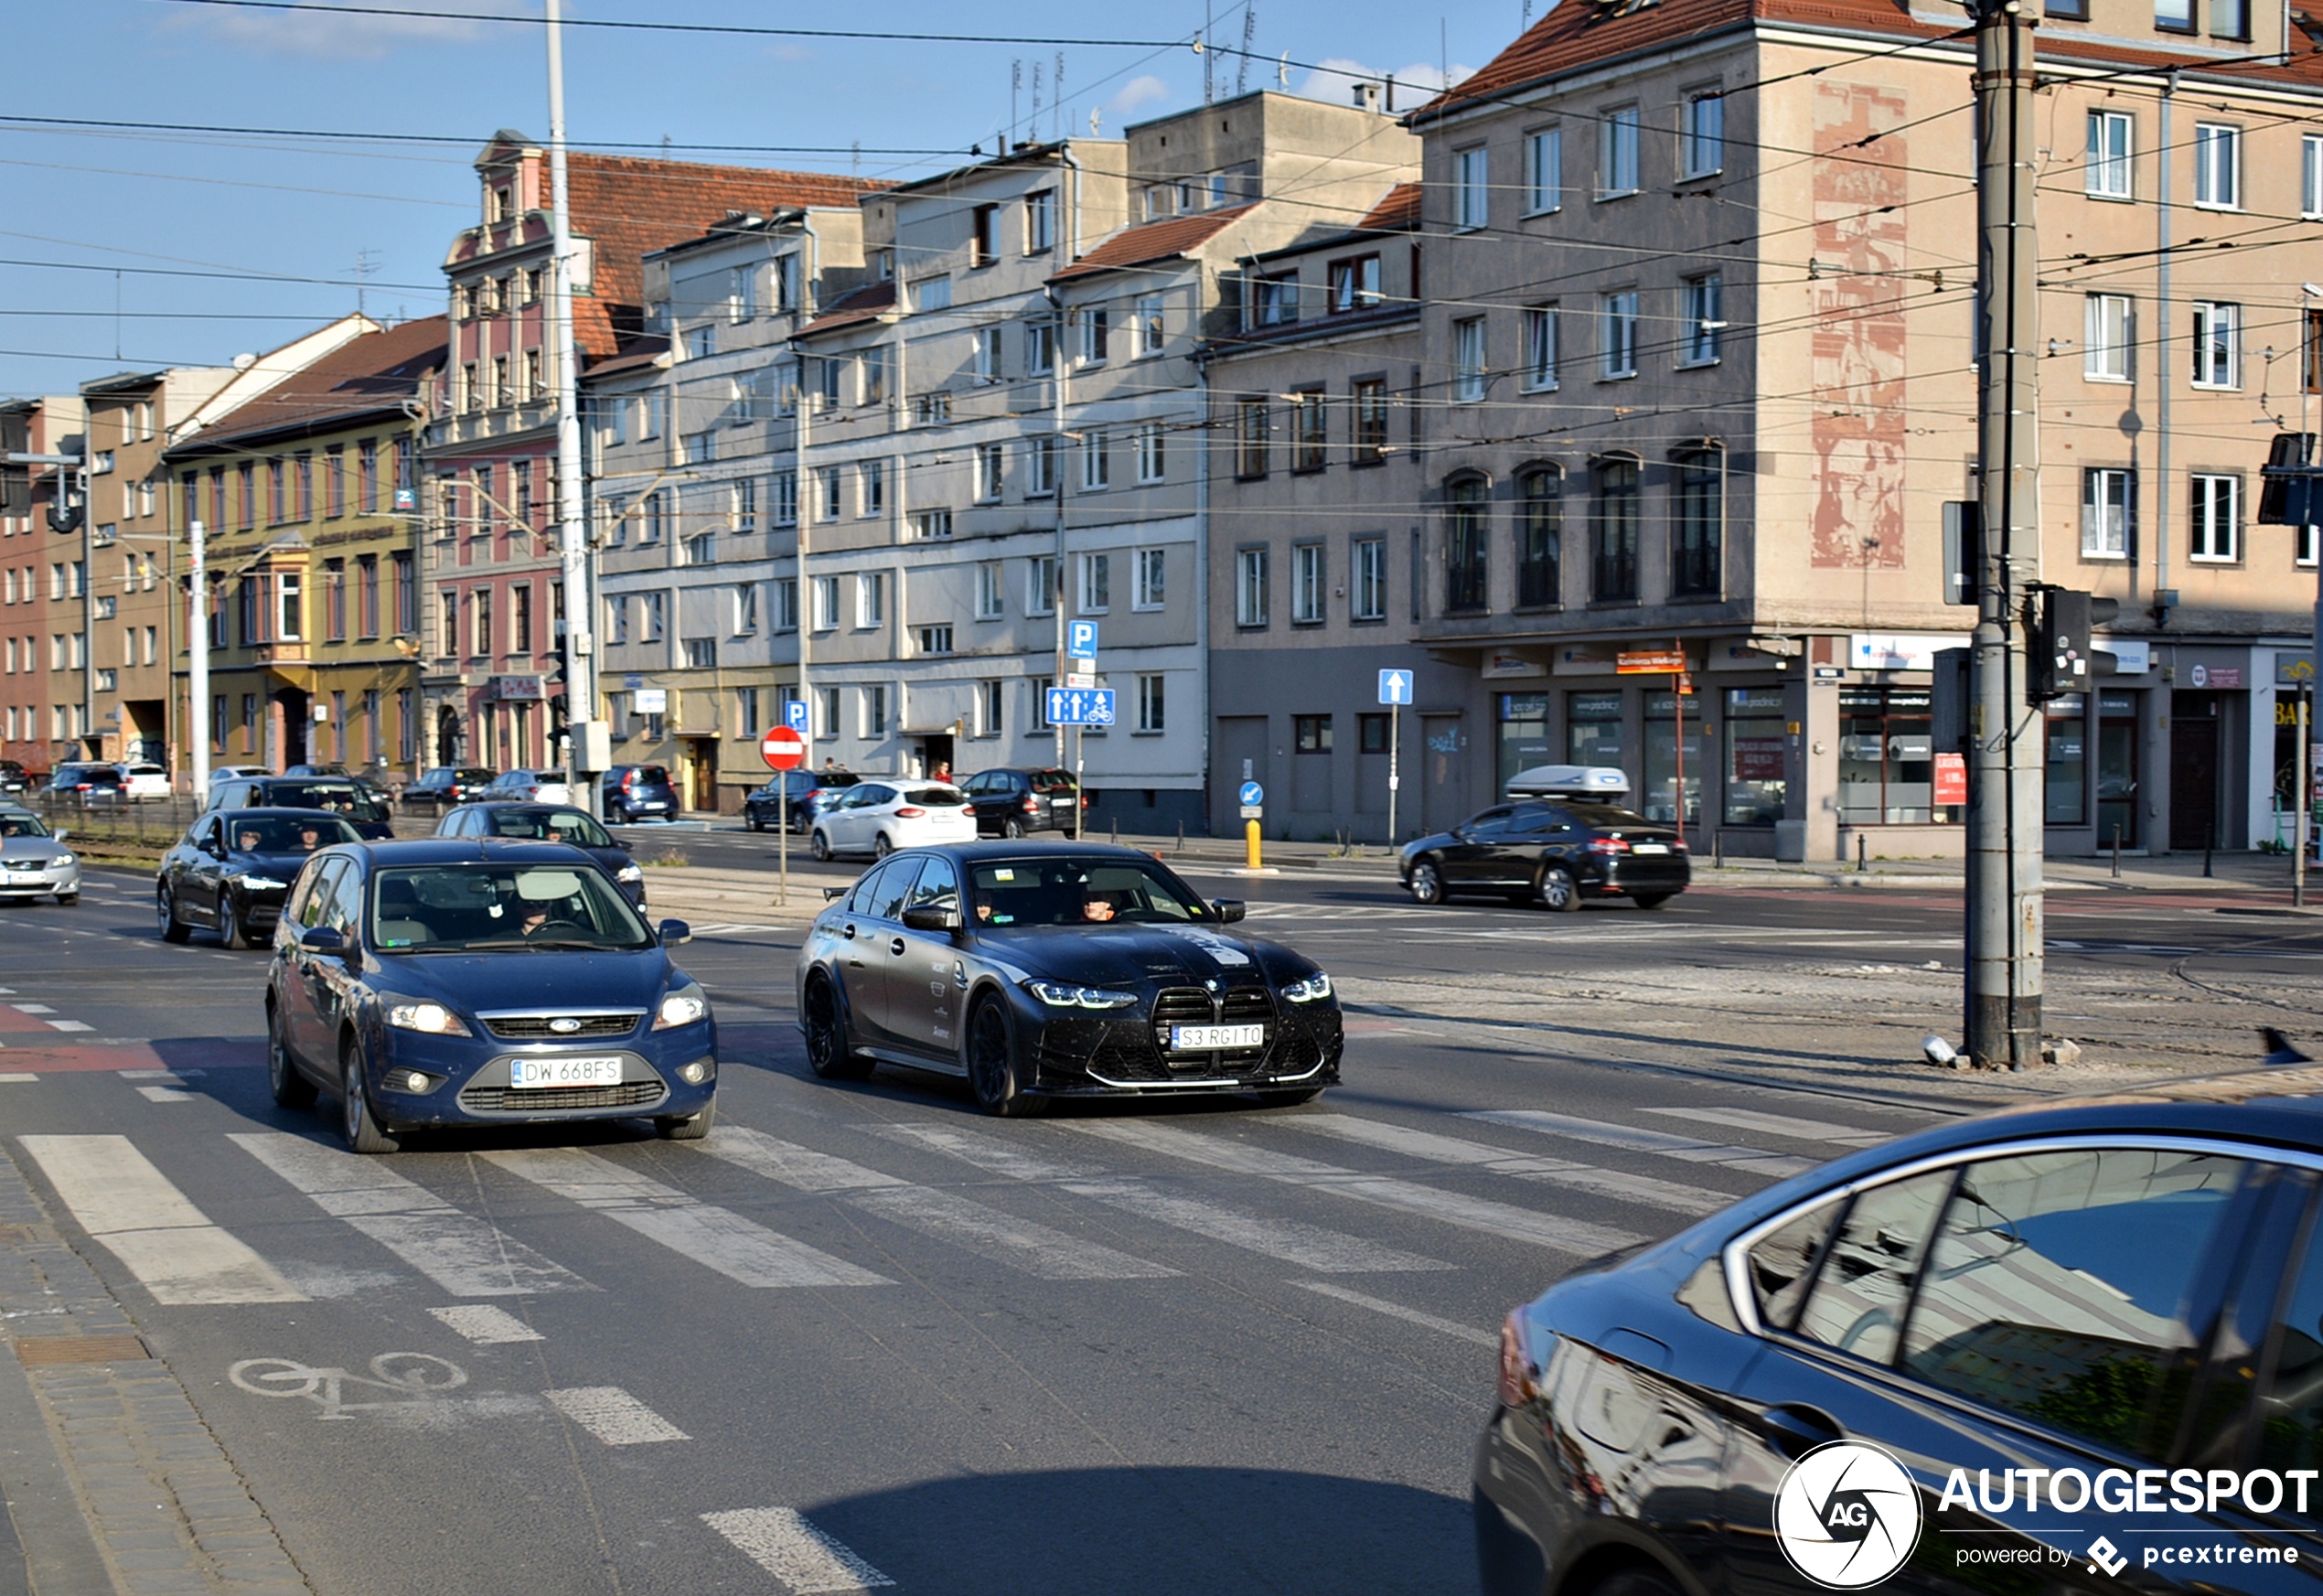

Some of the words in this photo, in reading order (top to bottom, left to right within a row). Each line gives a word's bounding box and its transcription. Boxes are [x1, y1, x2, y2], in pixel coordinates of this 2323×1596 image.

[1075, 624, 1092, 648] P
[790, 704, 804, 723] P
[1183, 1030, 1204, 1045] S3
[526, 1064, 552, 1081] DW
[560, 1061, 617, 1080] 668FS
